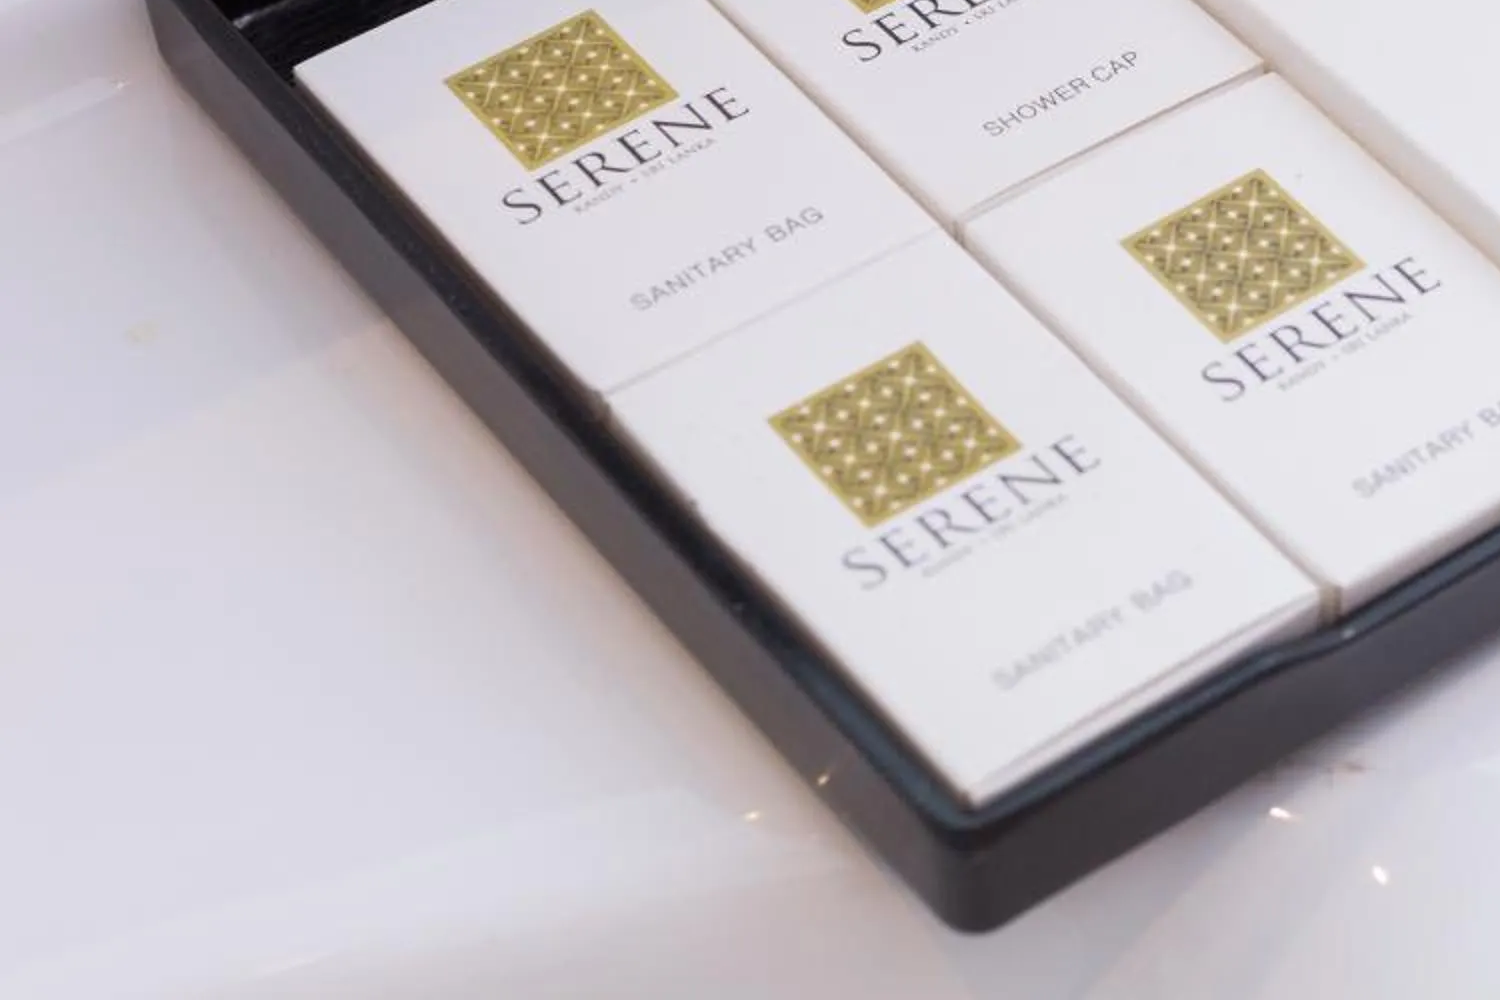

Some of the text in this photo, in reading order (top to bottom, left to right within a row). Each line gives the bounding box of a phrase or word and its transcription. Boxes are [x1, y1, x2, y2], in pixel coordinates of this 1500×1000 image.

[982, 51, 1138, 137] SHOWER CAP
[501, 87, 750, 226] SERENE
[629, 205, 824, 311] SANITARY BAG
[1200, 256, 1442, 404] SERENE
[841, 433, 1101, 591] SERENE
[1352, 419, 1475, 498] SANITARY
[990, 569, 1194, 691] SANITARY BAG
